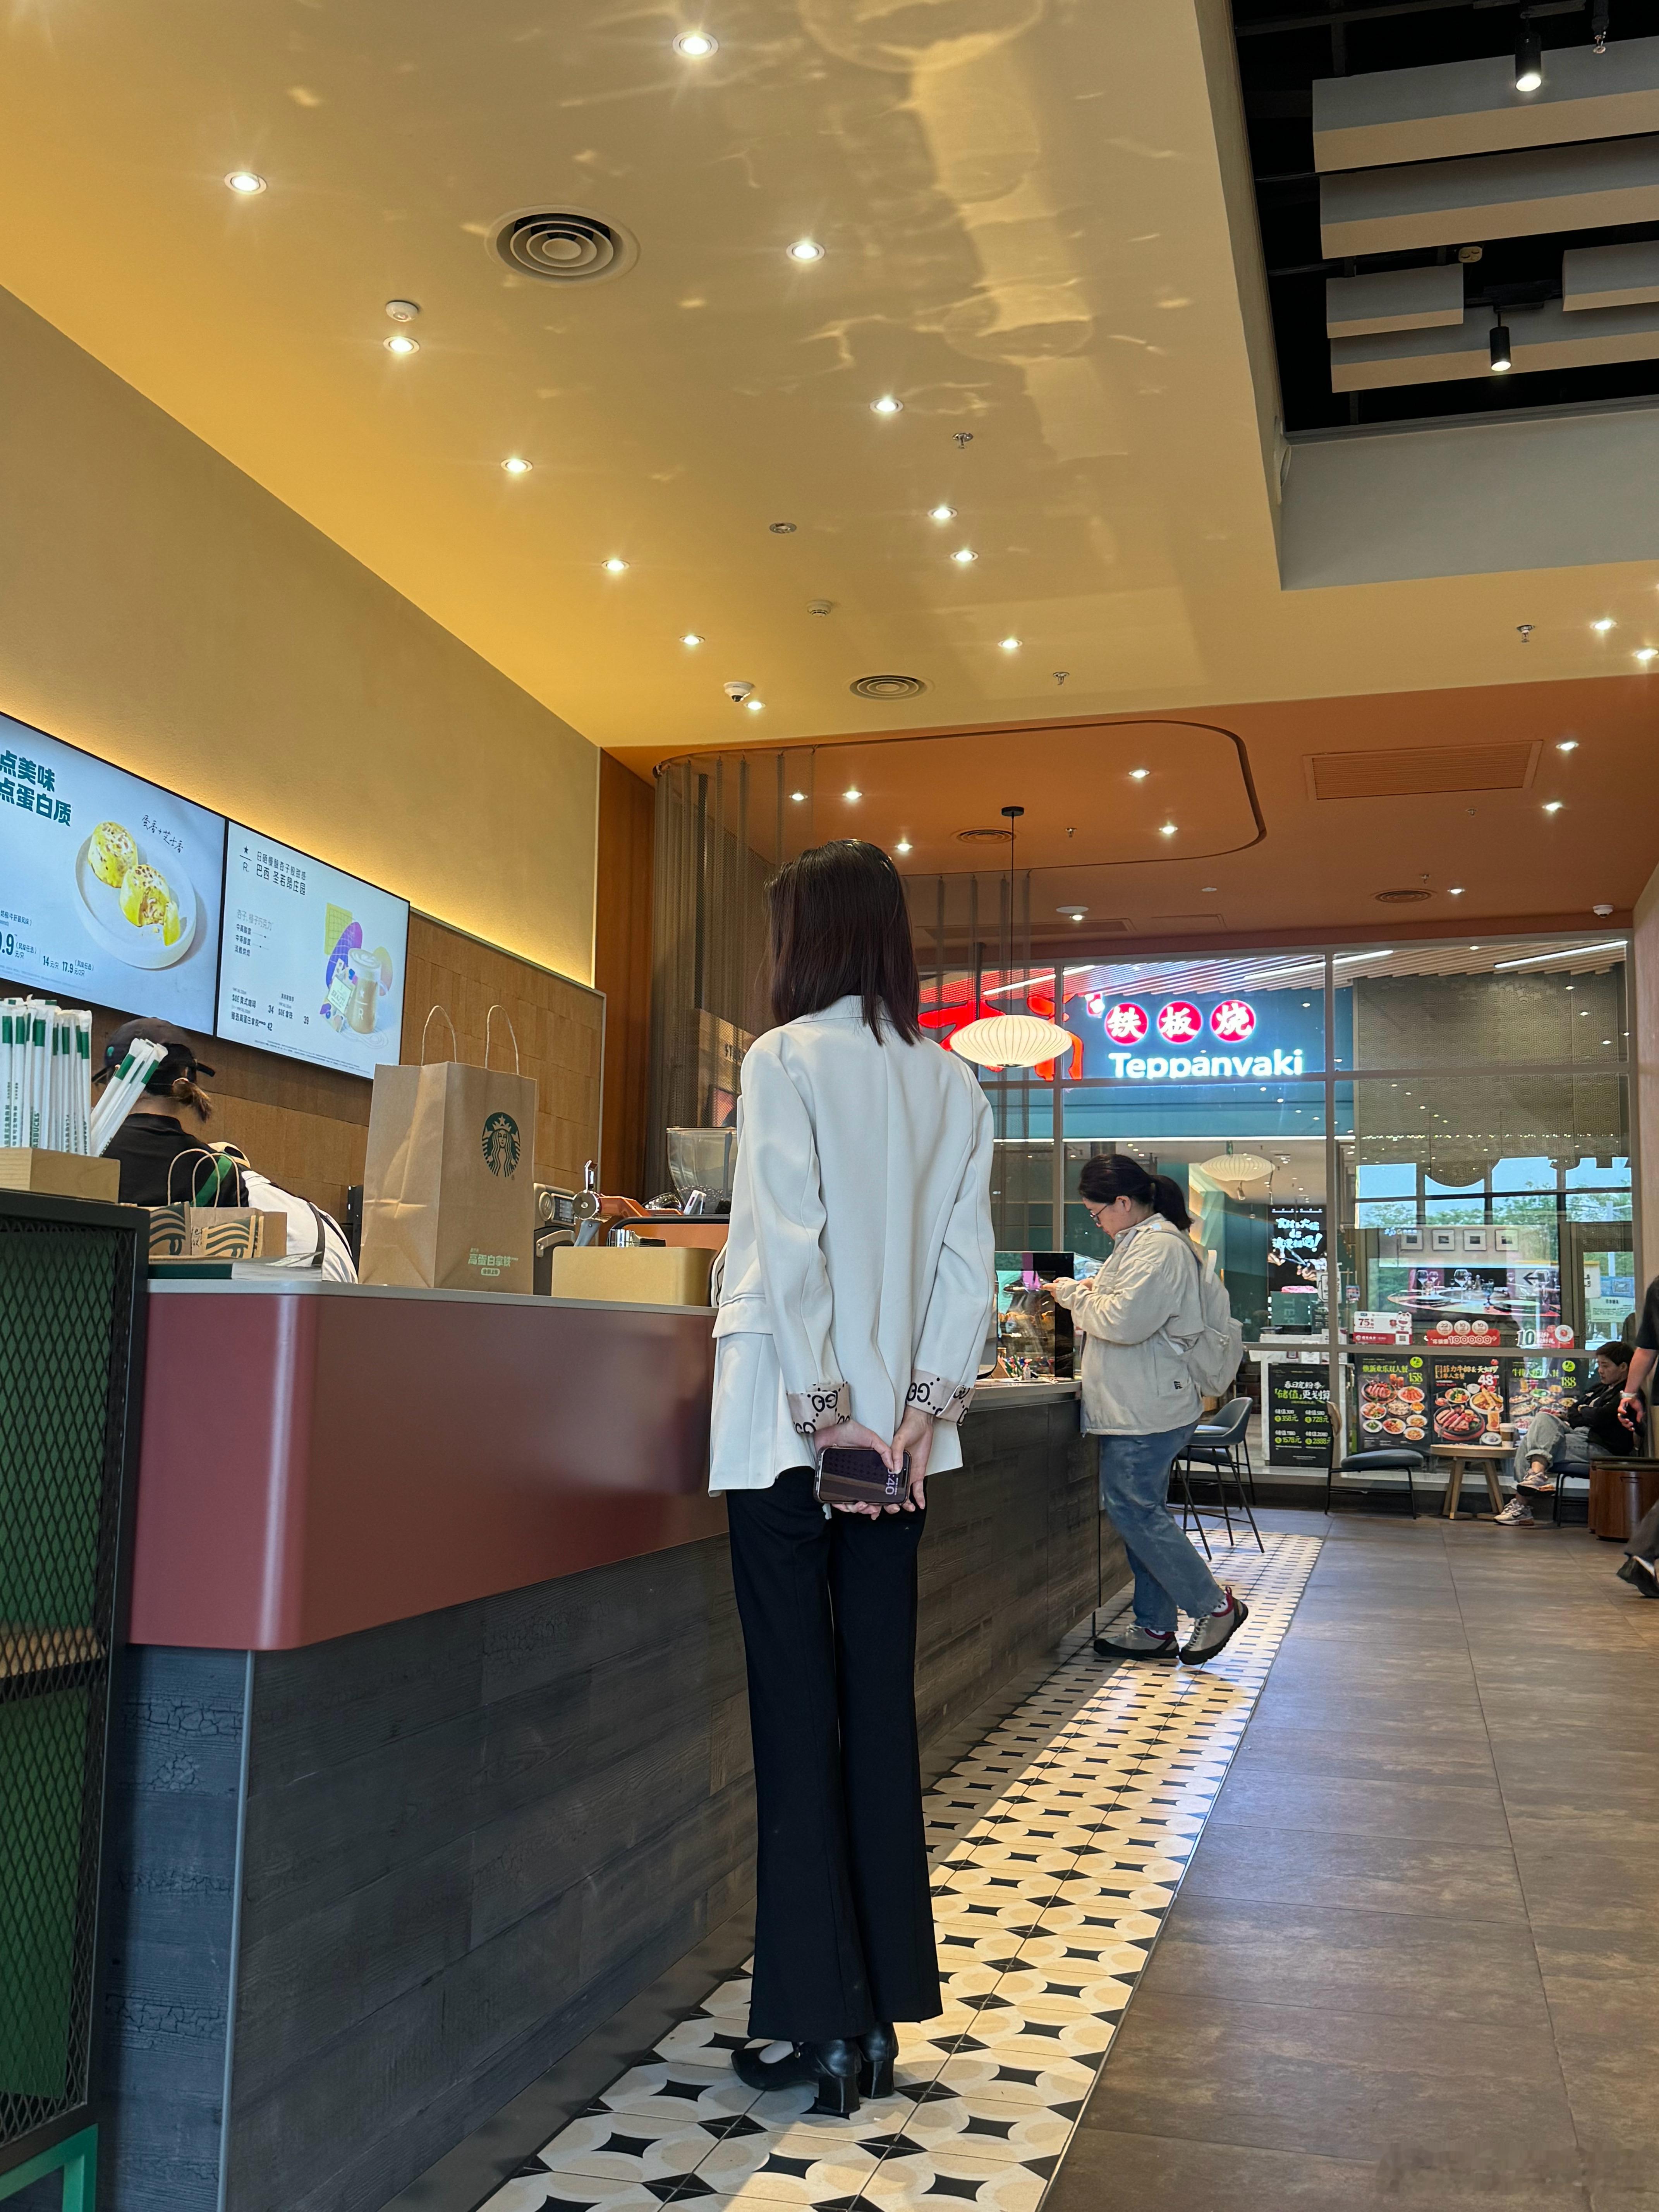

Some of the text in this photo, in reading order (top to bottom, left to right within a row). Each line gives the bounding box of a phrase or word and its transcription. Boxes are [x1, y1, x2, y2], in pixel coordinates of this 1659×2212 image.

[0, 750, 55, 792] 点美味
[0, 777, 72, 827] 点蛋白质
[256, 864, 270, 880] 巴西
[43, 955, 50, 967] 14
[62, 961, 74, 974] 17.9
[1108, 1003, 1252, 1039] 铁板烧
